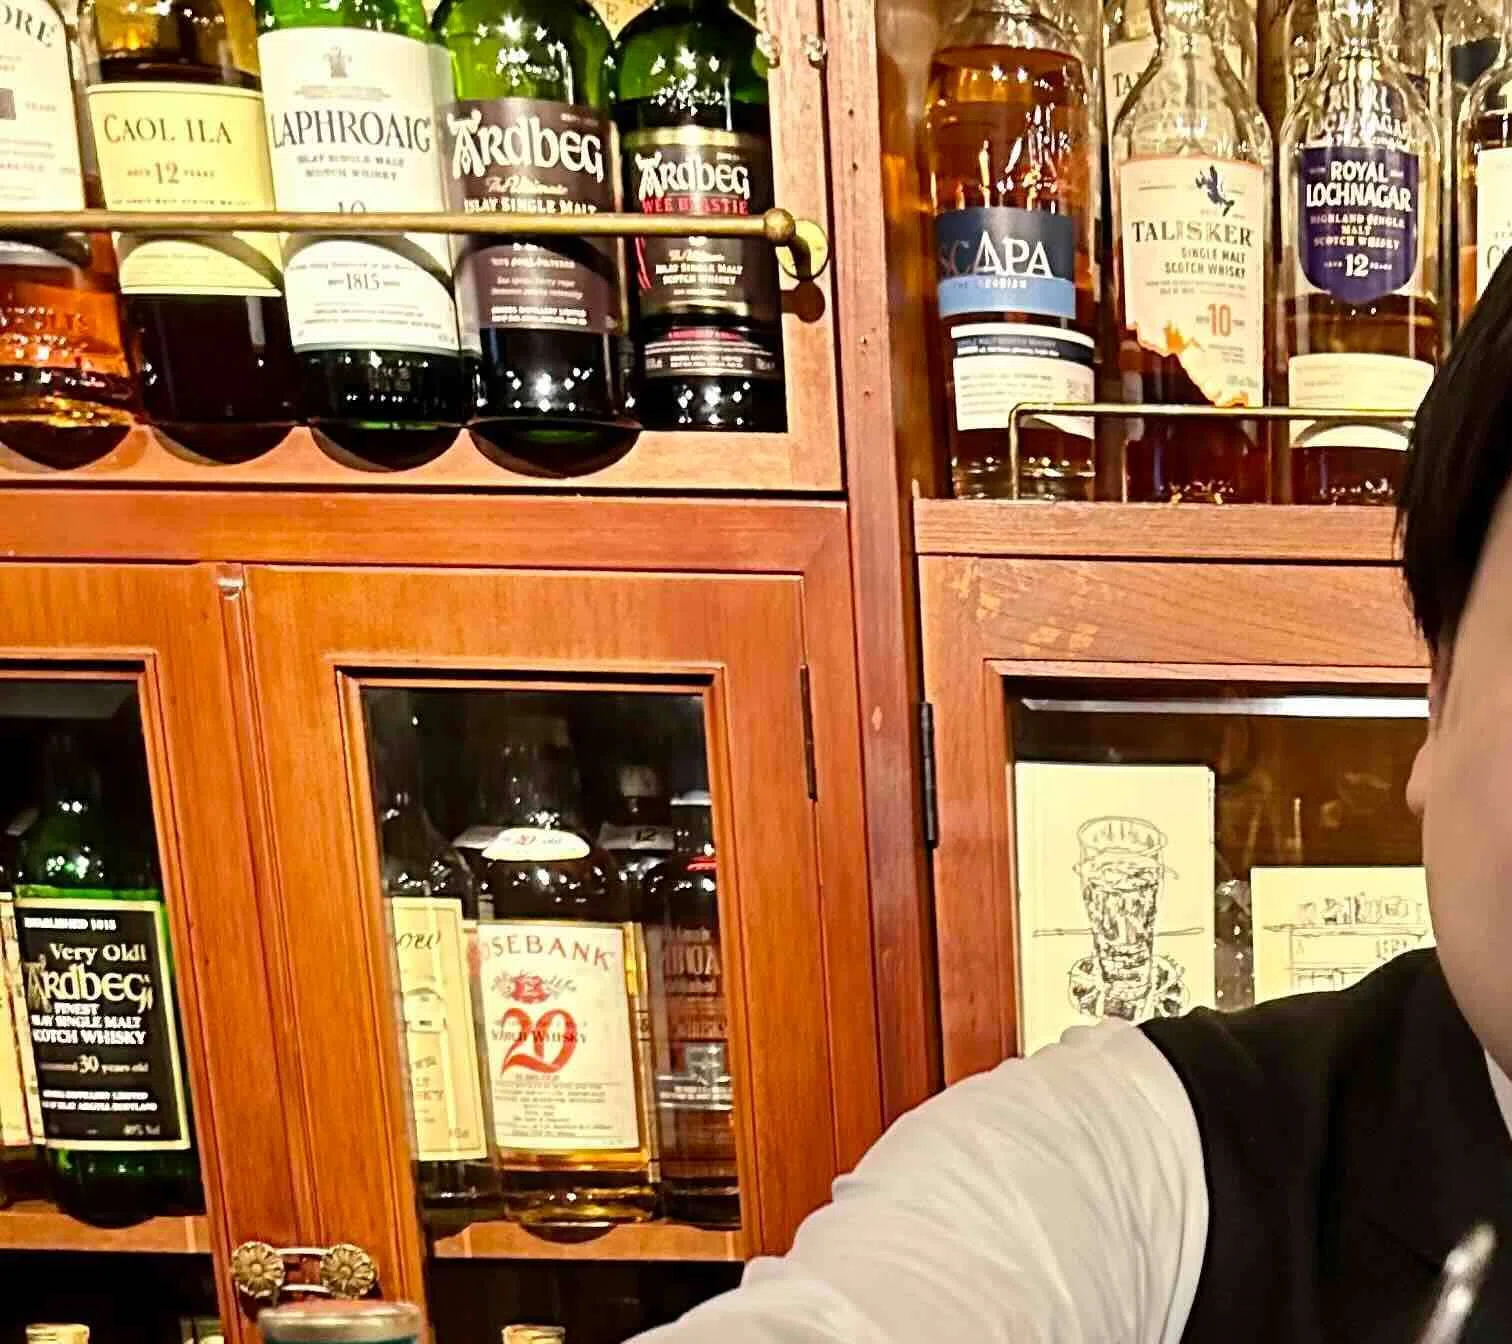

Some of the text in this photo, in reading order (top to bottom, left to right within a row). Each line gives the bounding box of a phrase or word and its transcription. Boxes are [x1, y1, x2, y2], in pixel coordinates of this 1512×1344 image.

[104, 113, 232, 144] CAOL ILA
[271, 109, 431, 152] LAPHROAIG
[155, 161, 180, 184] 12
[1330, 160, 1389, 182] ROYAL
[678, 198, 750, 216] BASTIE
[1306, 183, 1413, 212] LOCHNAGAR
[1131, 220, 1254, 248] TALISKER
[1345, 253, 1369, 277] 12
[1207, 303, 1232, 337] 10
[49, 943, 98, 966] Very
[491, 935, 611, 971] SEBANK
[501, 1007, 578, 1076] 20
[79, 1053, 99, 1074] 30
